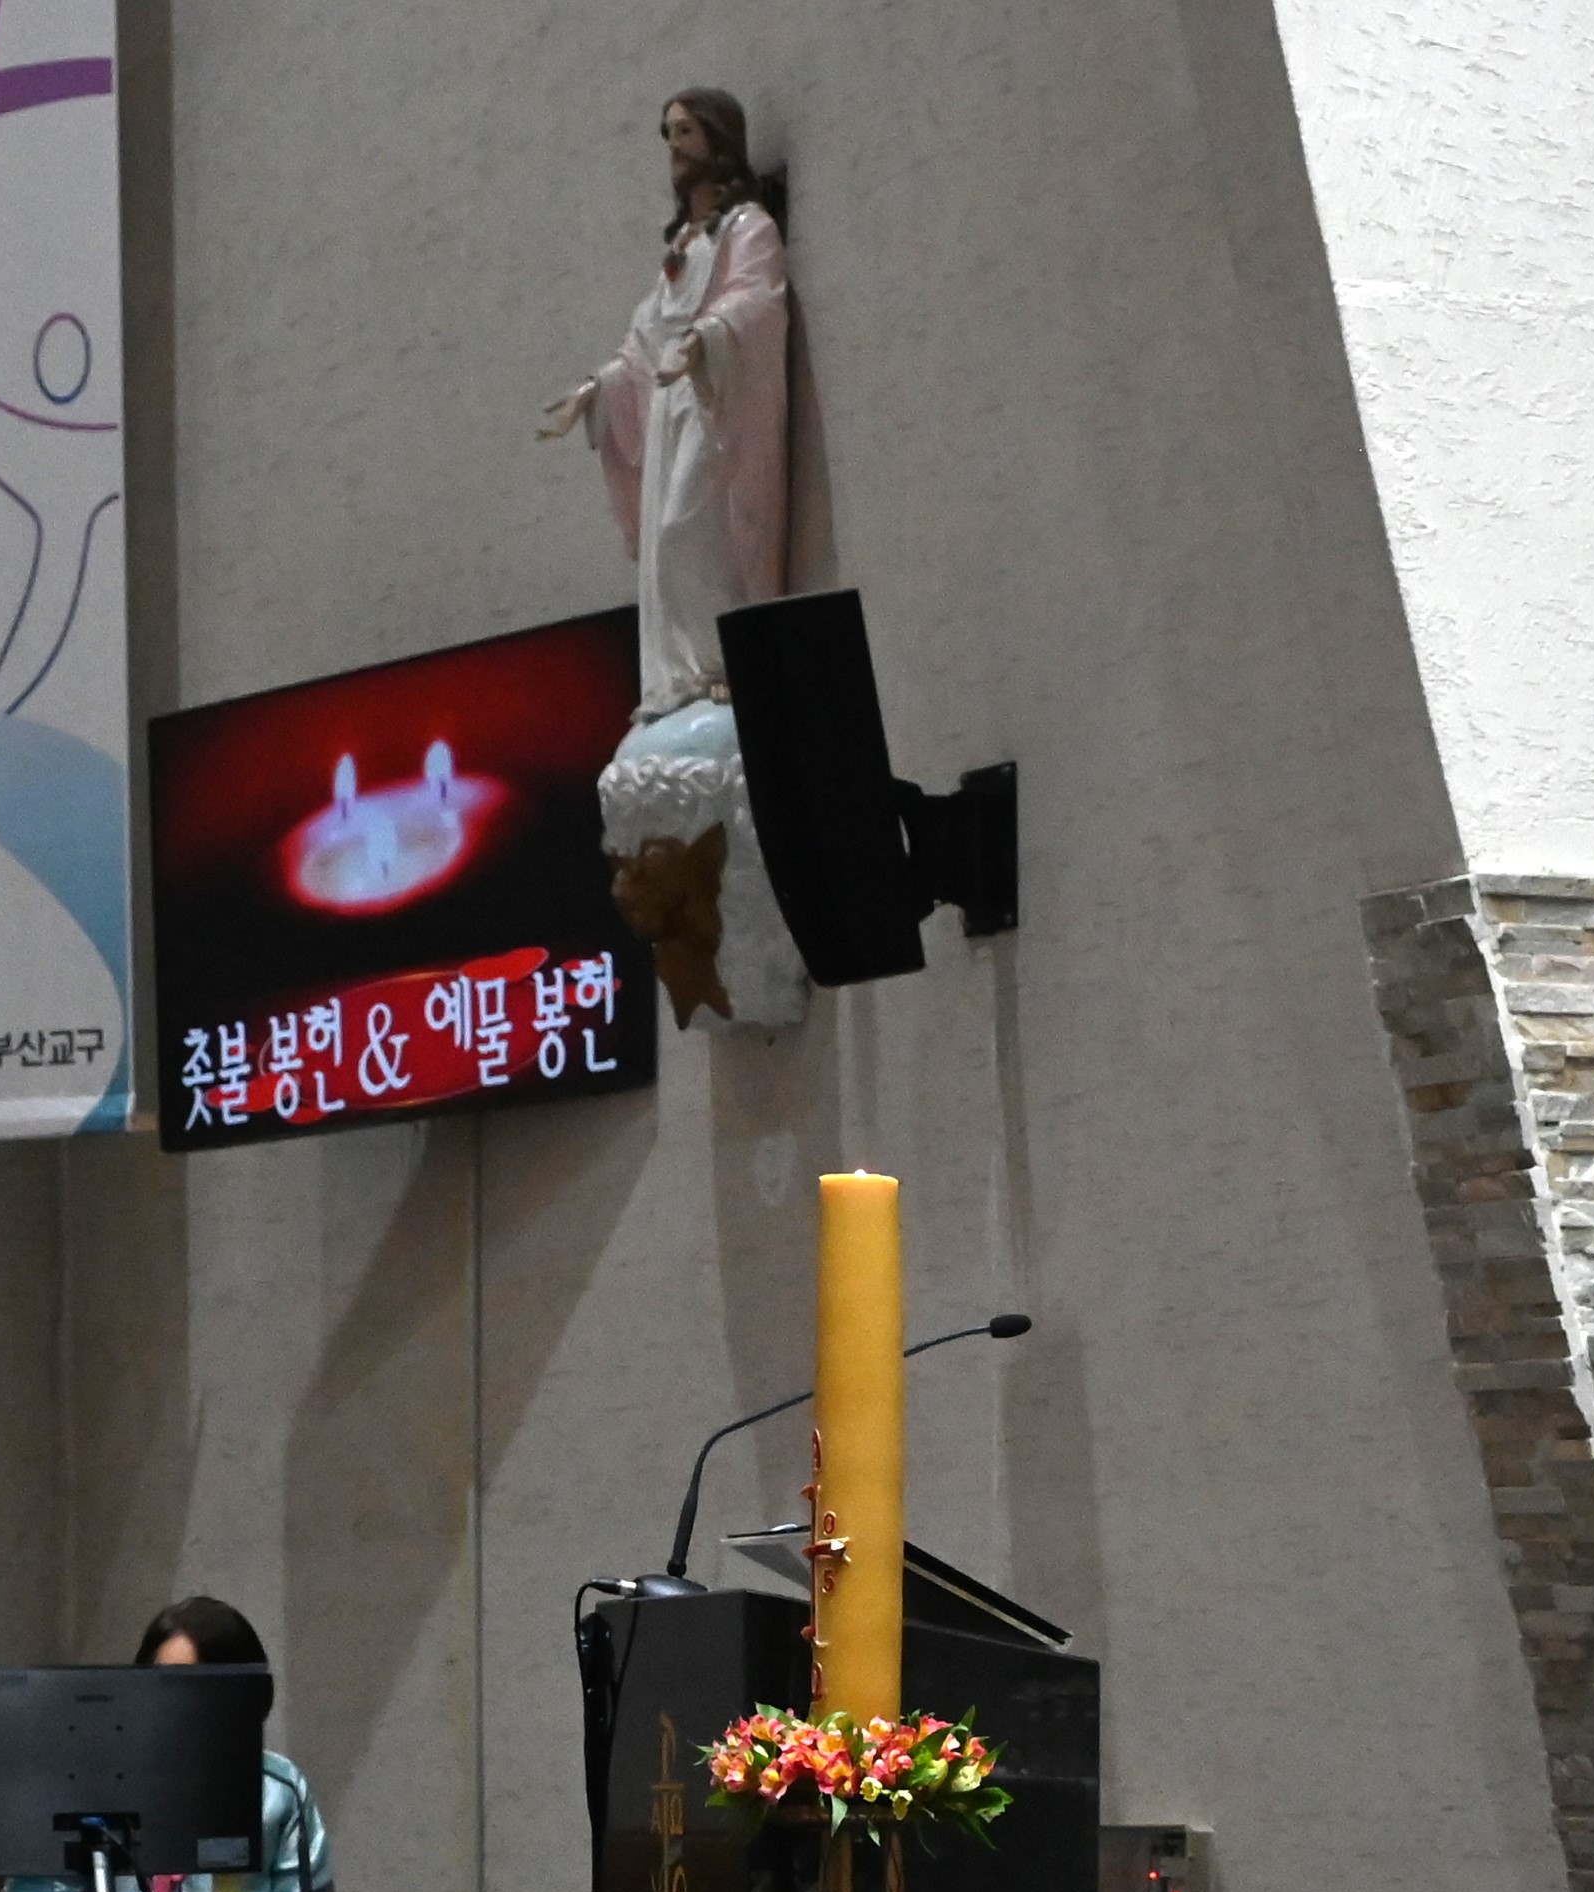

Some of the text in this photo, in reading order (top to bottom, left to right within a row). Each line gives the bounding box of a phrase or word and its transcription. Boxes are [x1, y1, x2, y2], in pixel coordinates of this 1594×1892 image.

[181, 951, 618, 1132] 촛불 봉헌 & 예물 봉헌
